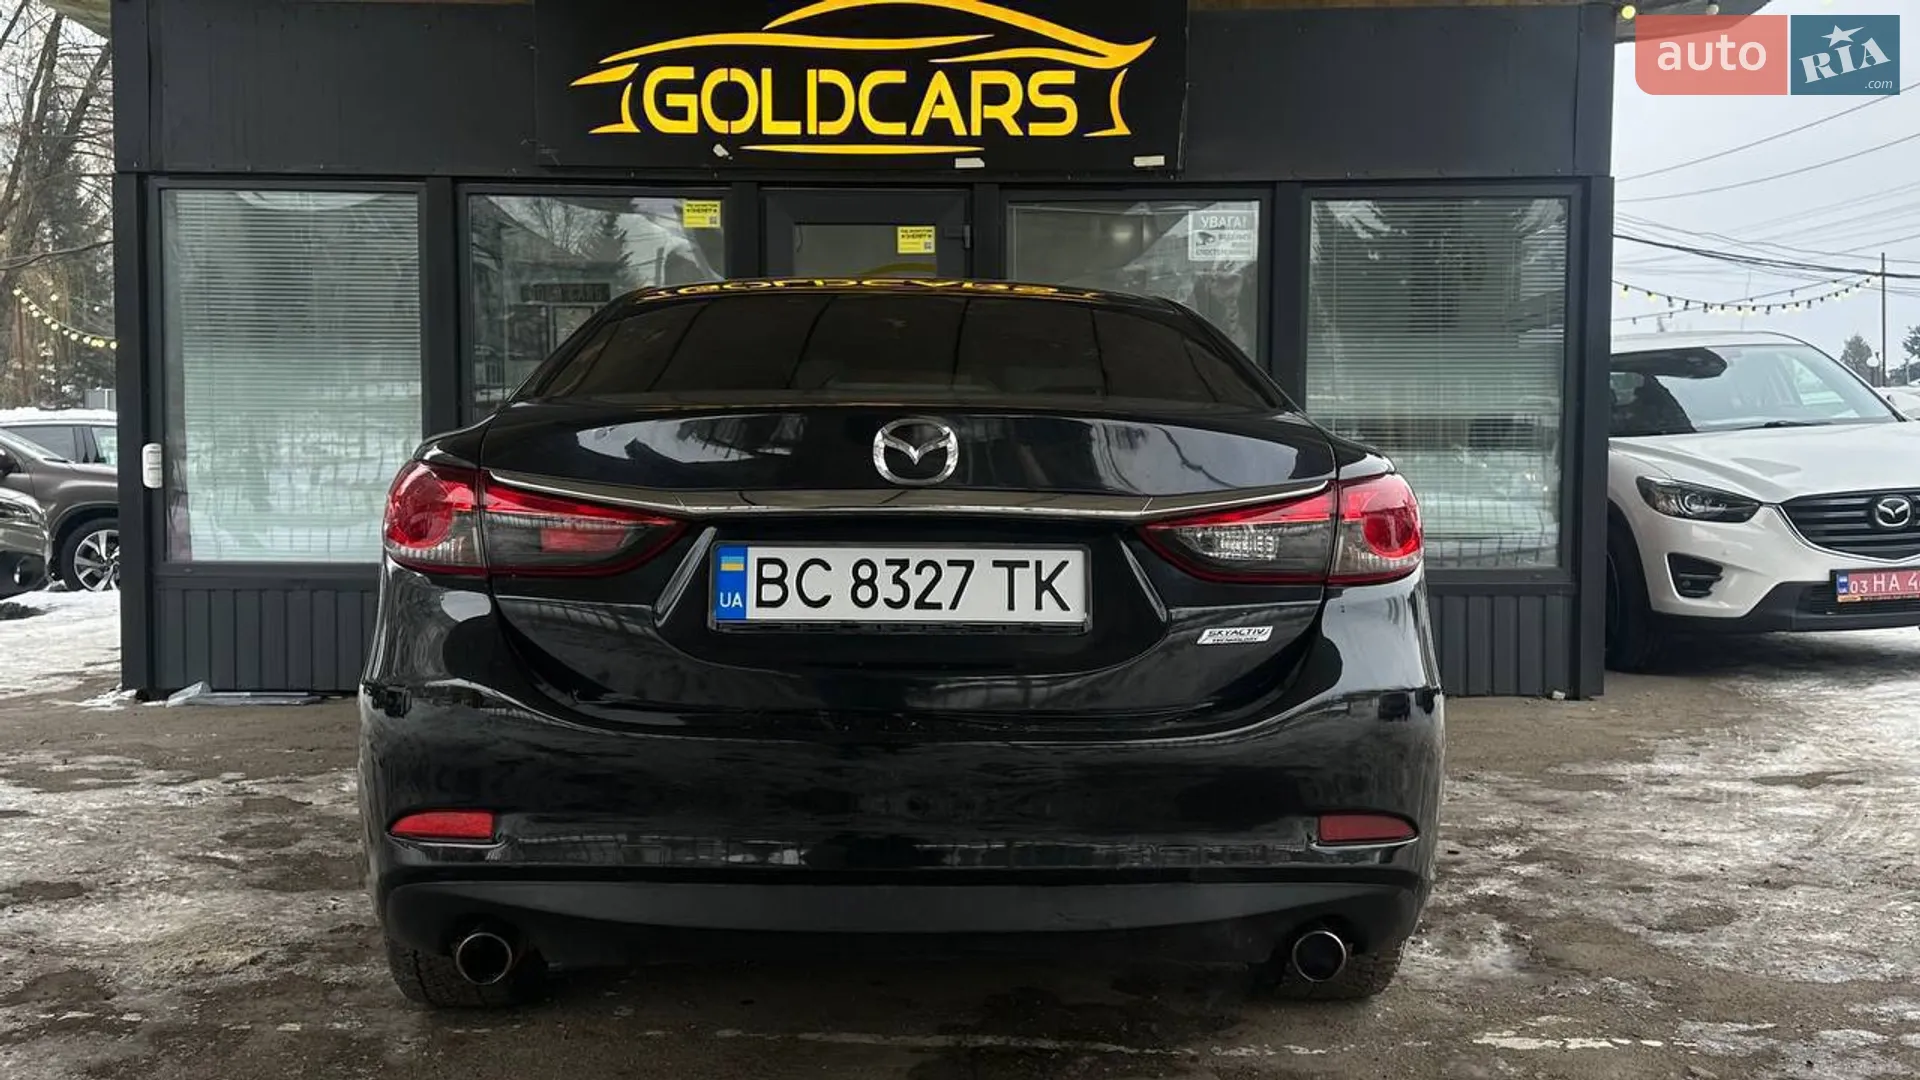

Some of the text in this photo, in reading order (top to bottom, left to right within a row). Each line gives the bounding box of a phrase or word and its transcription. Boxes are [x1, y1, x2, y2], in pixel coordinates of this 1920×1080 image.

[642, 66, 1078, 137] GOLDCARS
[719, 592, 744, 608] UA
[755, 556, 1071, 612] BC 8327 TK
[1850, 572, 1920, 594] 03 HA 4
